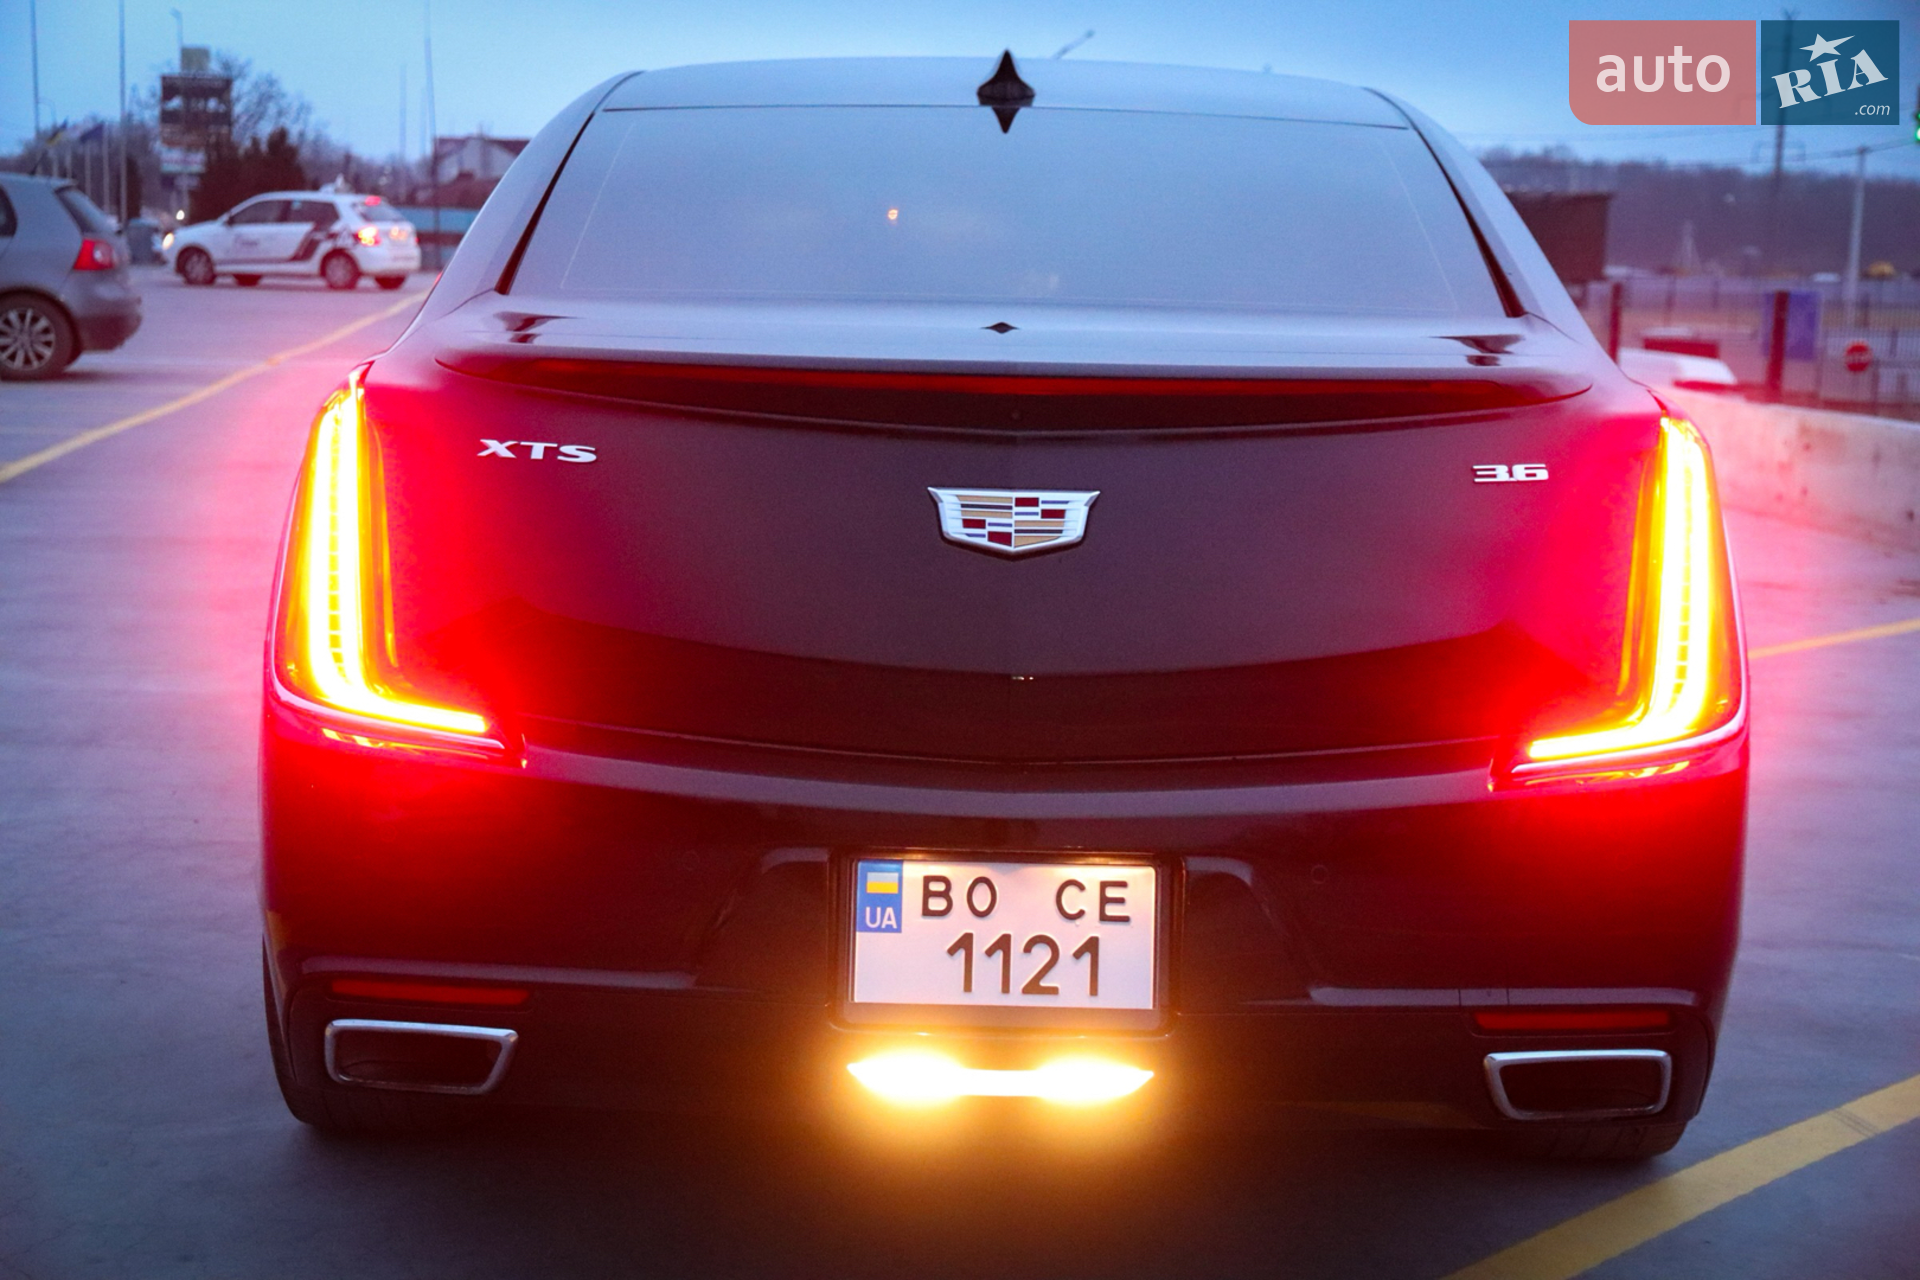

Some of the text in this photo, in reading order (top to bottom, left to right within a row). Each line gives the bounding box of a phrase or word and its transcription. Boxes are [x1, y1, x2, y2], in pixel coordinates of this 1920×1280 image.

[477, 438, 598, 463] XTS
[921, 874, 1131, 923] BO CE
[865, 907, 898, 929] UA
[946, 932, 1100, 997] 1121
